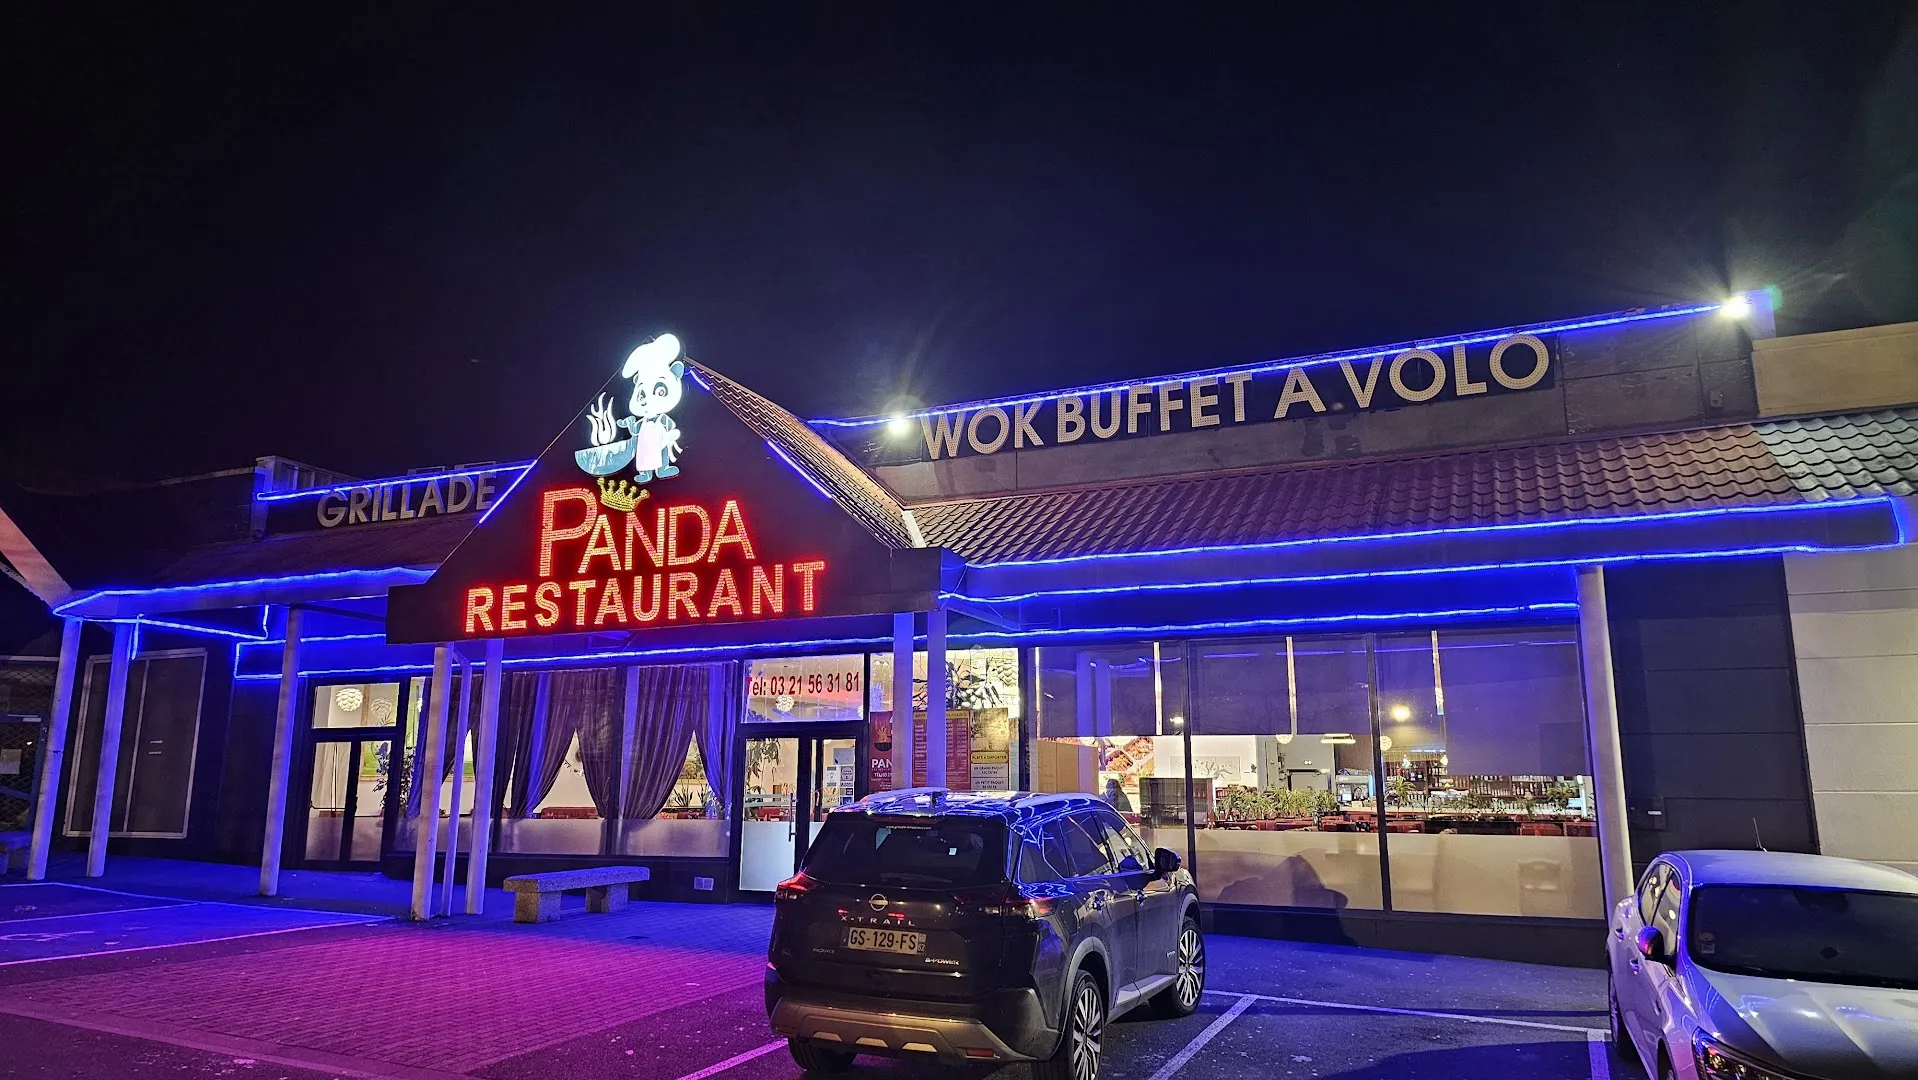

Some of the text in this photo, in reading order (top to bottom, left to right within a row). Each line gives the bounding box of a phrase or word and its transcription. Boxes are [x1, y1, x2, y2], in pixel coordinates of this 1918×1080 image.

[919, 333, 1550, 460] WOK BUFFET A VOLO
[316, 472, 498, 528] GRILLADE
[539, 486, 756, 577] PANDA
[465, 560, 825, 633] RESTAURANT
[770, 675, 785, 696] 03
[788, 675, 802, 695] 21
[808, 673, 823, 694] 56
[827, 672, 840, 693] 31
[845, 671, 860, 692] 81
[841, 915, 916, 927] X-TRAIL
[849, 929, 918, 951] GS-129-FS
